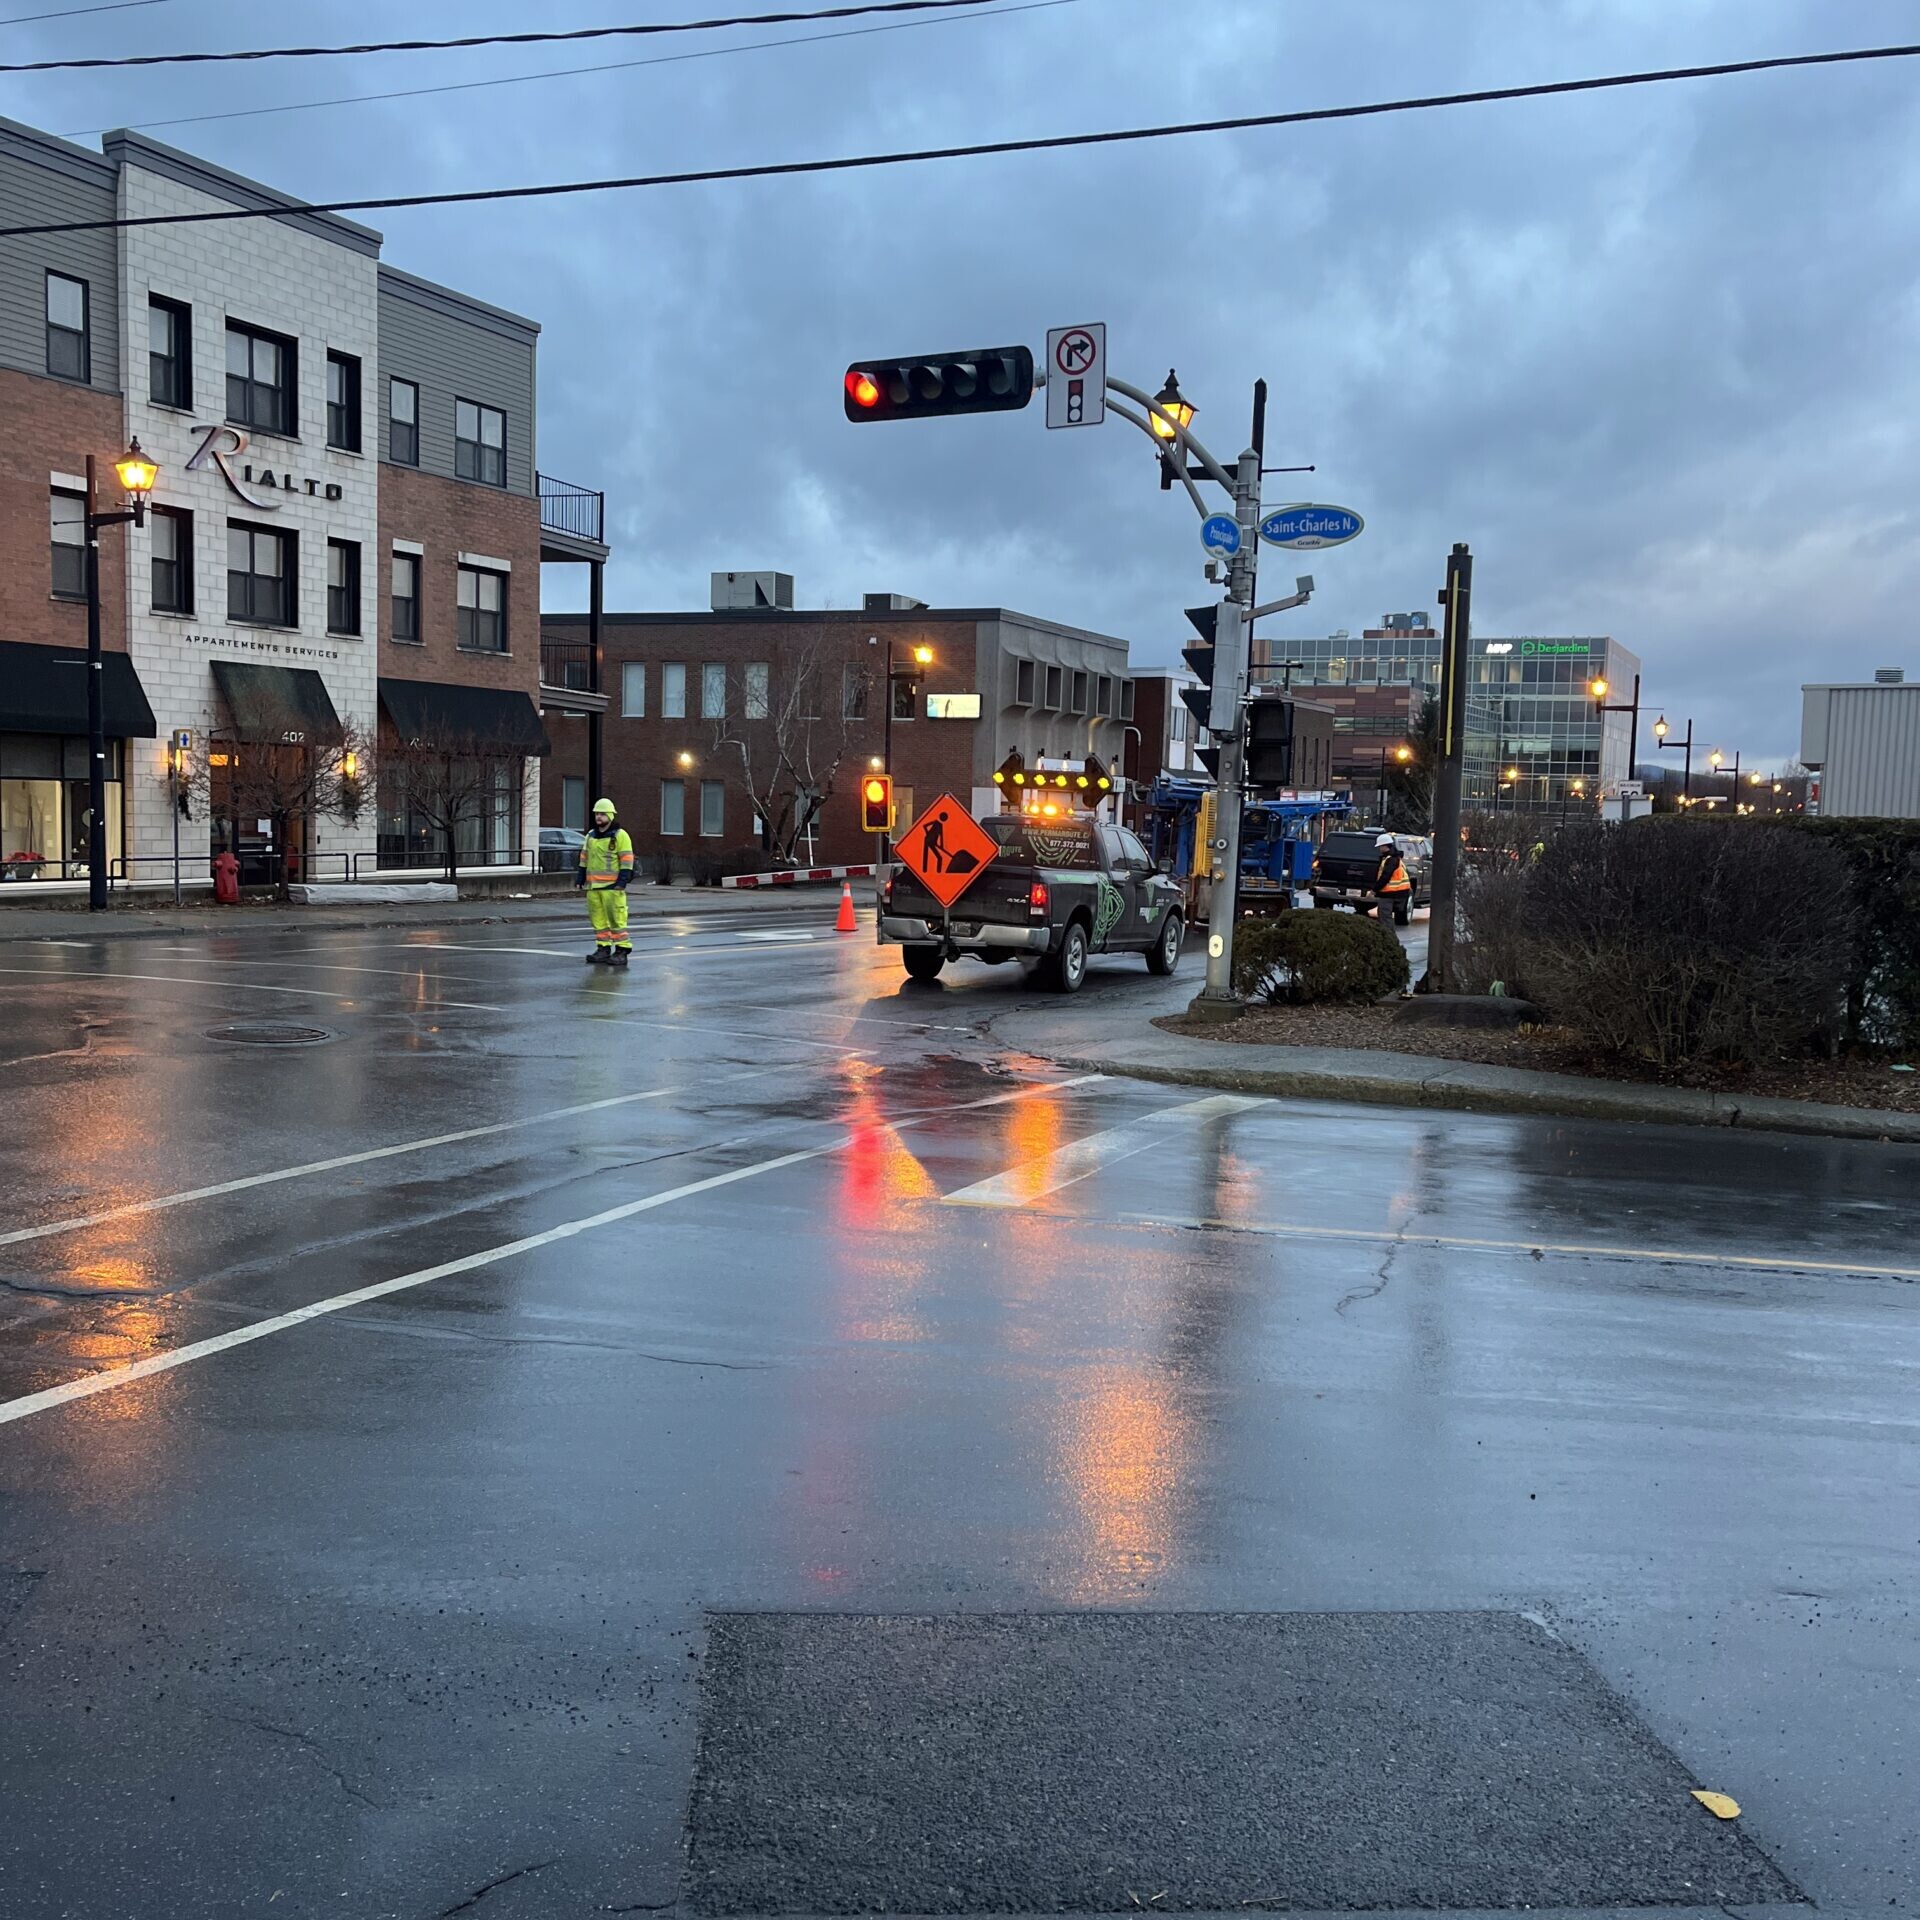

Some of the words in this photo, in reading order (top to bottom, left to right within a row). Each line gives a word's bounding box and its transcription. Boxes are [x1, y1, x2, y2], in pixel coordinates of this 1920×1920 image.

[185, 425, 343, 512] RIALTO
[1266, 517, 1340, 534] Saint-Charles
[1342, 517, 1355, 530] N.
[185, 634, 279, 652] APPARTEMENTS
[285, 647, 338, 659] SERVICES
[1538, 643, 1589, 654] Desjardins
[281, 731, 305, 743] 402
